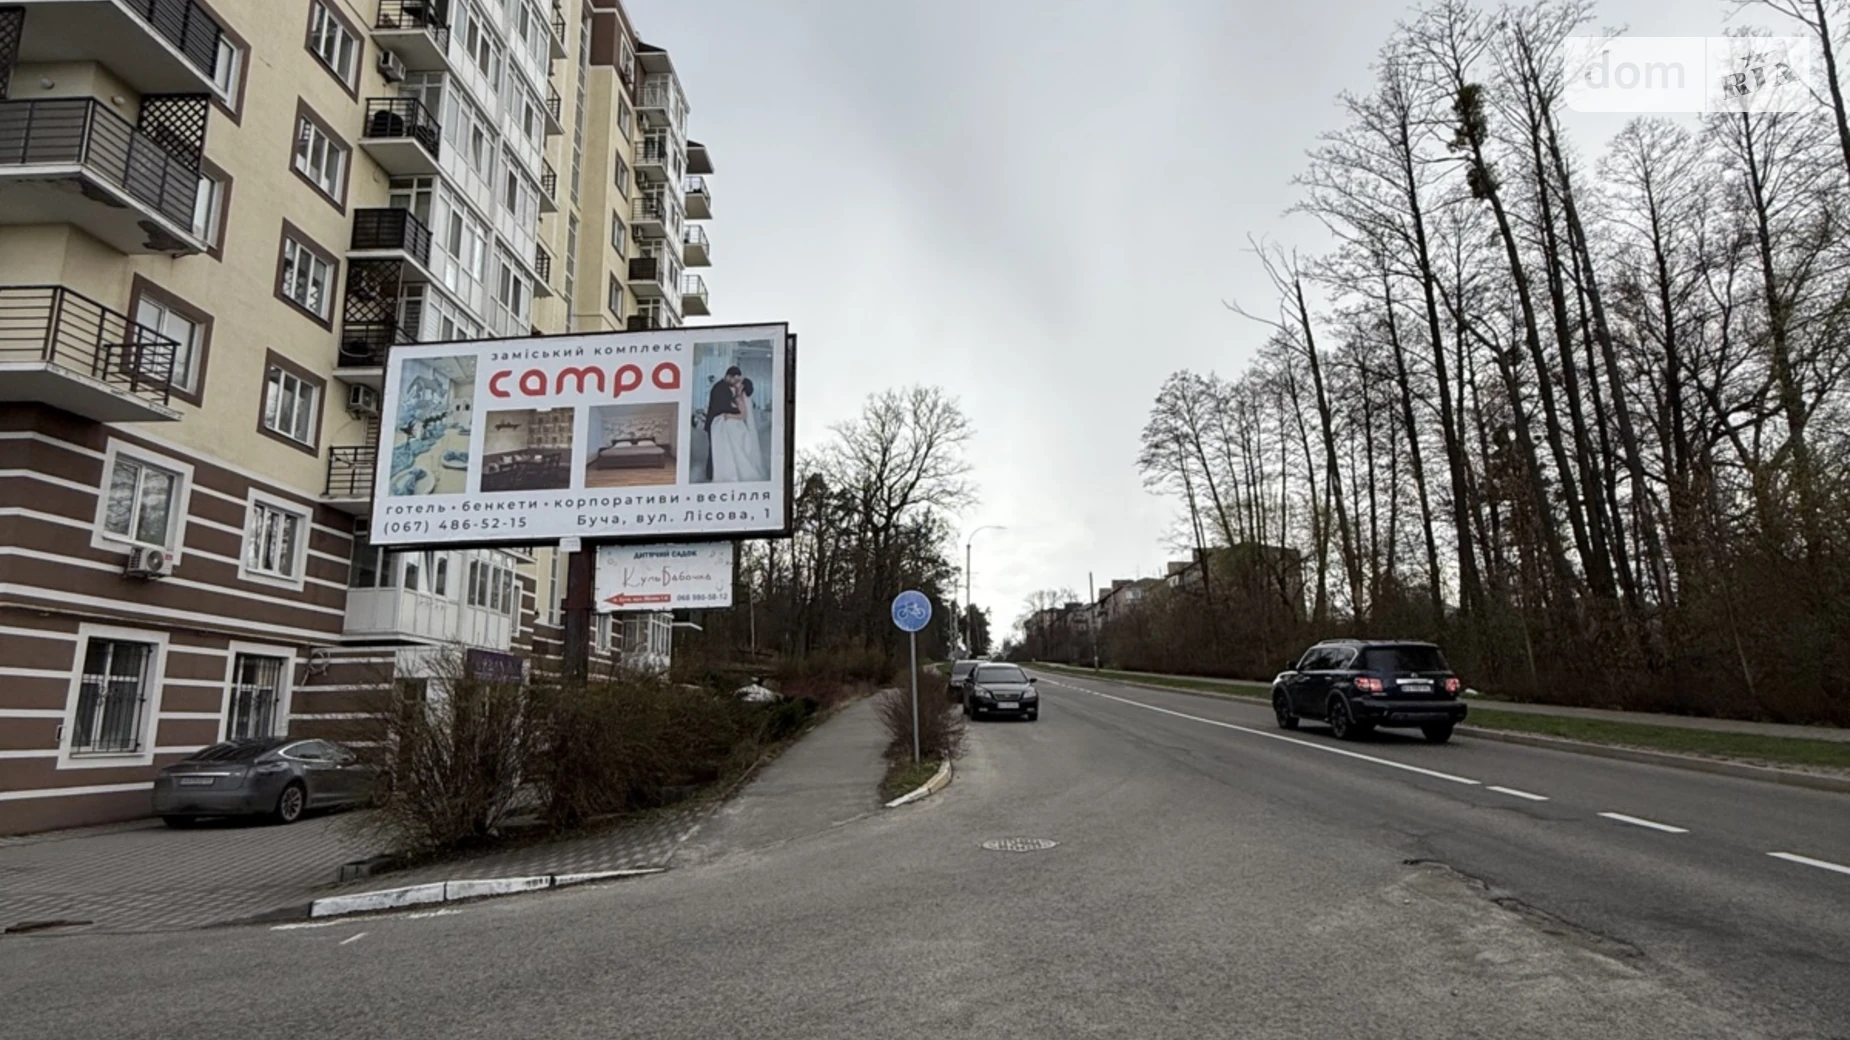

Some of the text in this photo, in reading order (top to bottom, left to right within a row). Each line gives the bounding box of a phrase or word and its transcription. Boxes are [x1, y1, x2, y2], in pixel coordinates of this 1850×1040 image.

[491, 343, 682, 361] заміський комплекс
[386, 490, 771, 515] готель бенкети корпоративи весілля
[383, 516, 527, 535] (067) 486-52-15
[577, 507, 770, 528] Буча, вул. Лісова, 1
[671, 549, 698, 559] САДОК
